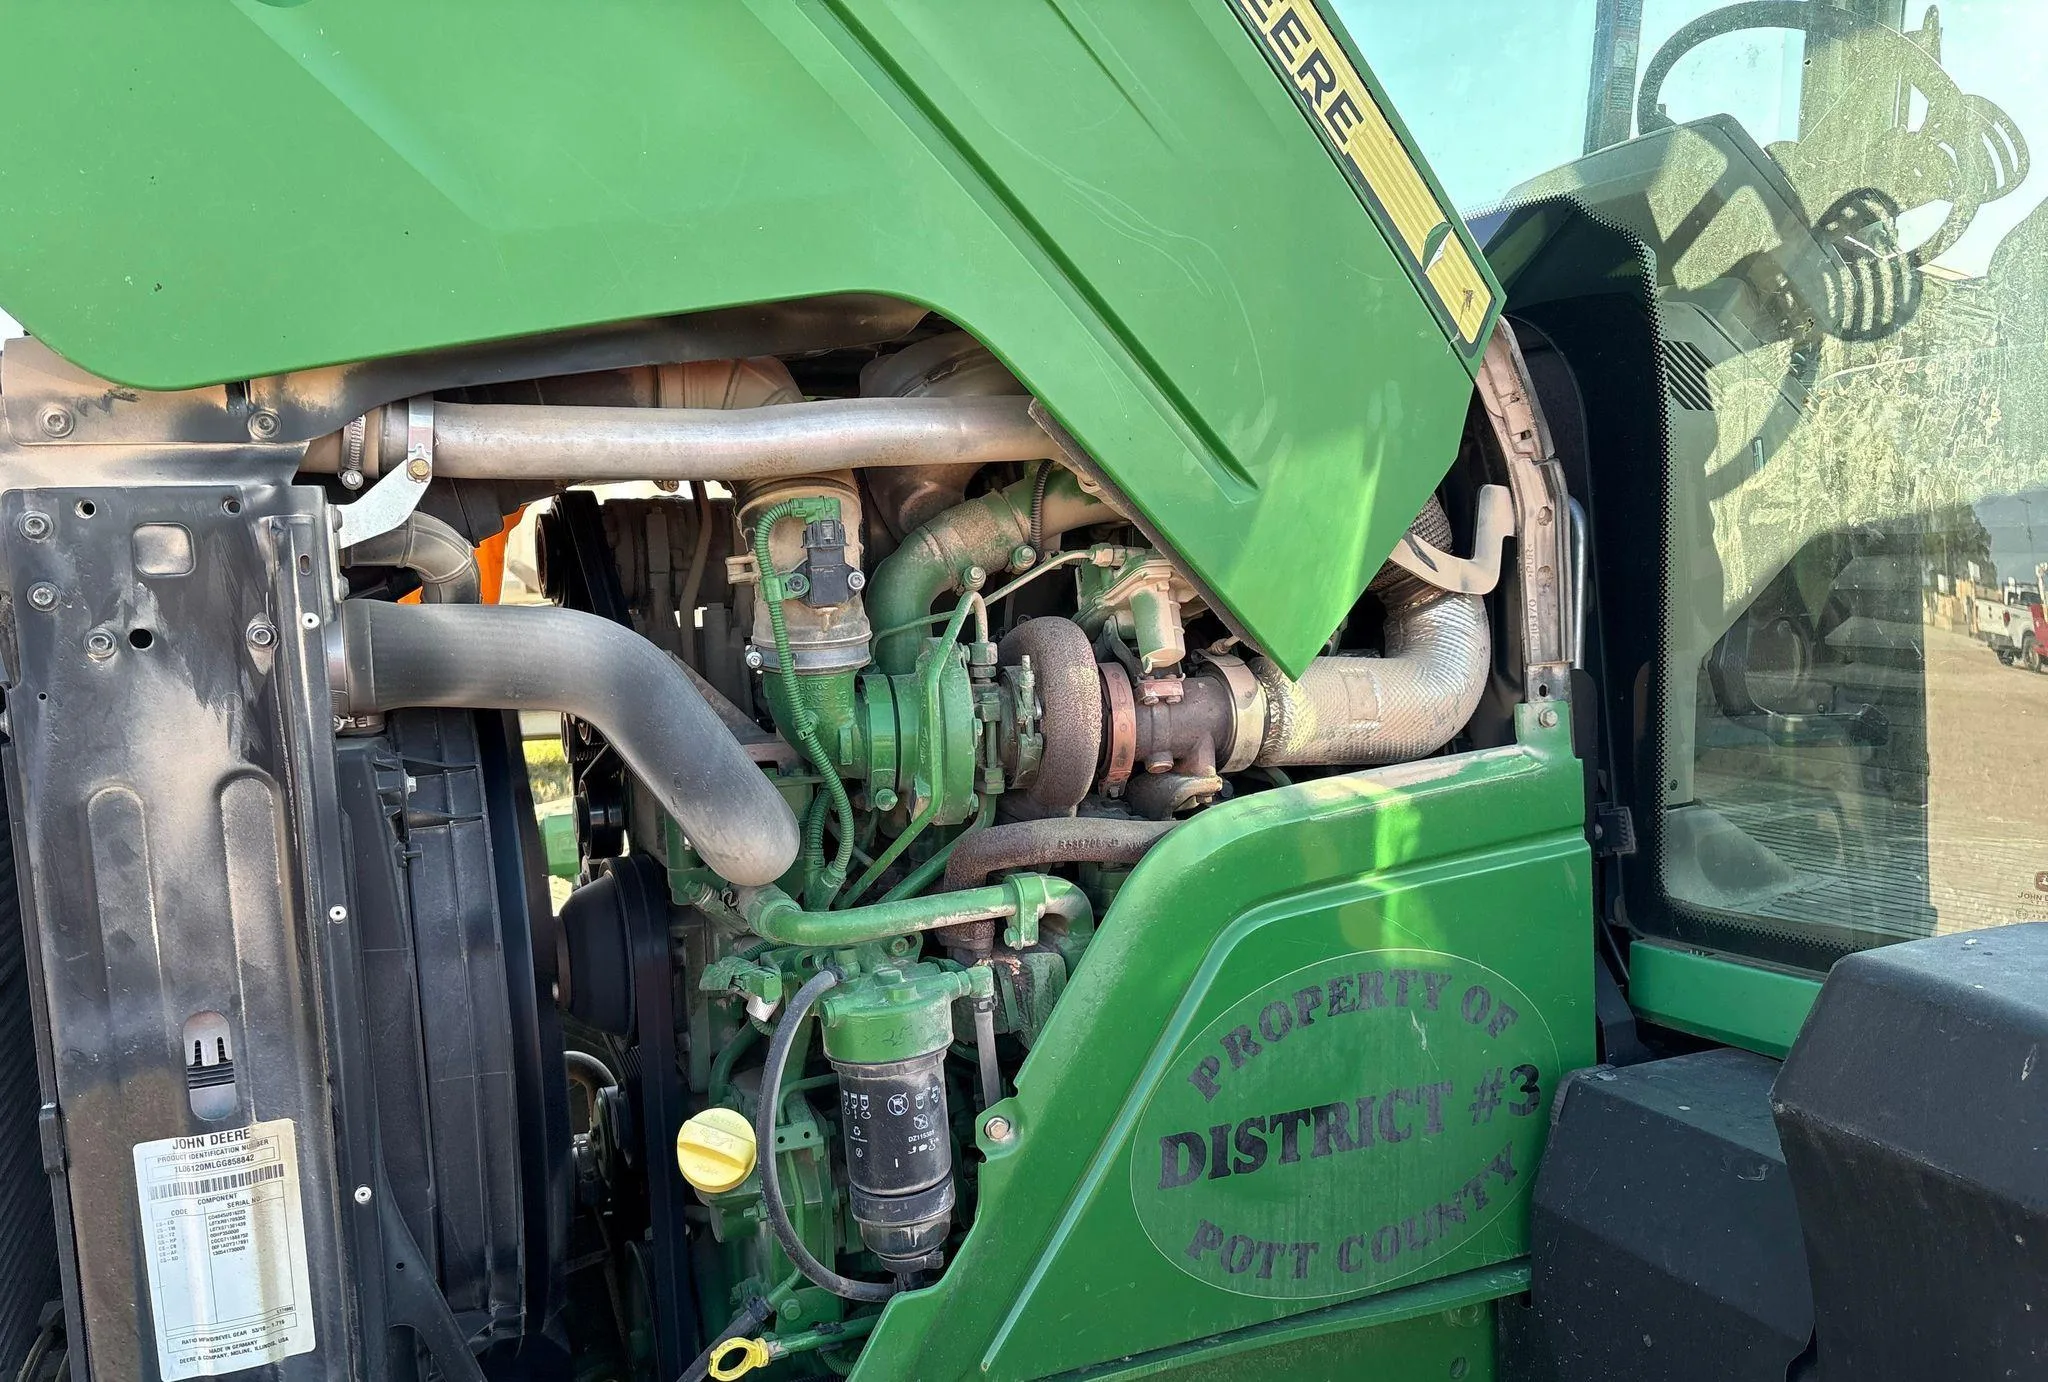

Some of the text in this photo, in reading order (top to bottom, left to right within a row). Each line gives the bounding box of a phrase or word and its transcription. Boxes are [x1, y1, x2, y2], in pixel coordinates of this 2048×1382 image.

[2017, 891, 2043, 901] JOHN
[1186, 968, 1519, 1103] PROPERTY OF
[1157, 1063, 1542, 1190] DISTRICT #3
[172, 1128, 250, 1150] JOHN DEERE
[157, 1154, 187, 1163] PRODUCT
[189, 1146, 240, 1160] IDENTIFICATION
[197, 1193, 238, 1206] COMPONENT
[227, 1200, 250, 1209] SERIAL
[170, 1208, 188, 1216] CODE
[1184, 1140, 1518, 1280] POTT COUNTY
[181, 1337, 198, 1345] RATIO
[208, 1346, 223, 1354] MADE
[231, 1340, 258, 1350] GERMANY
[179, 1356, 197, 1364] DEERE
[202, 1351, 229, 1360] COMPANY,
[230, 1348, 253, 1356] MOLINE,
[278, 1336, 290, 1344] USA
